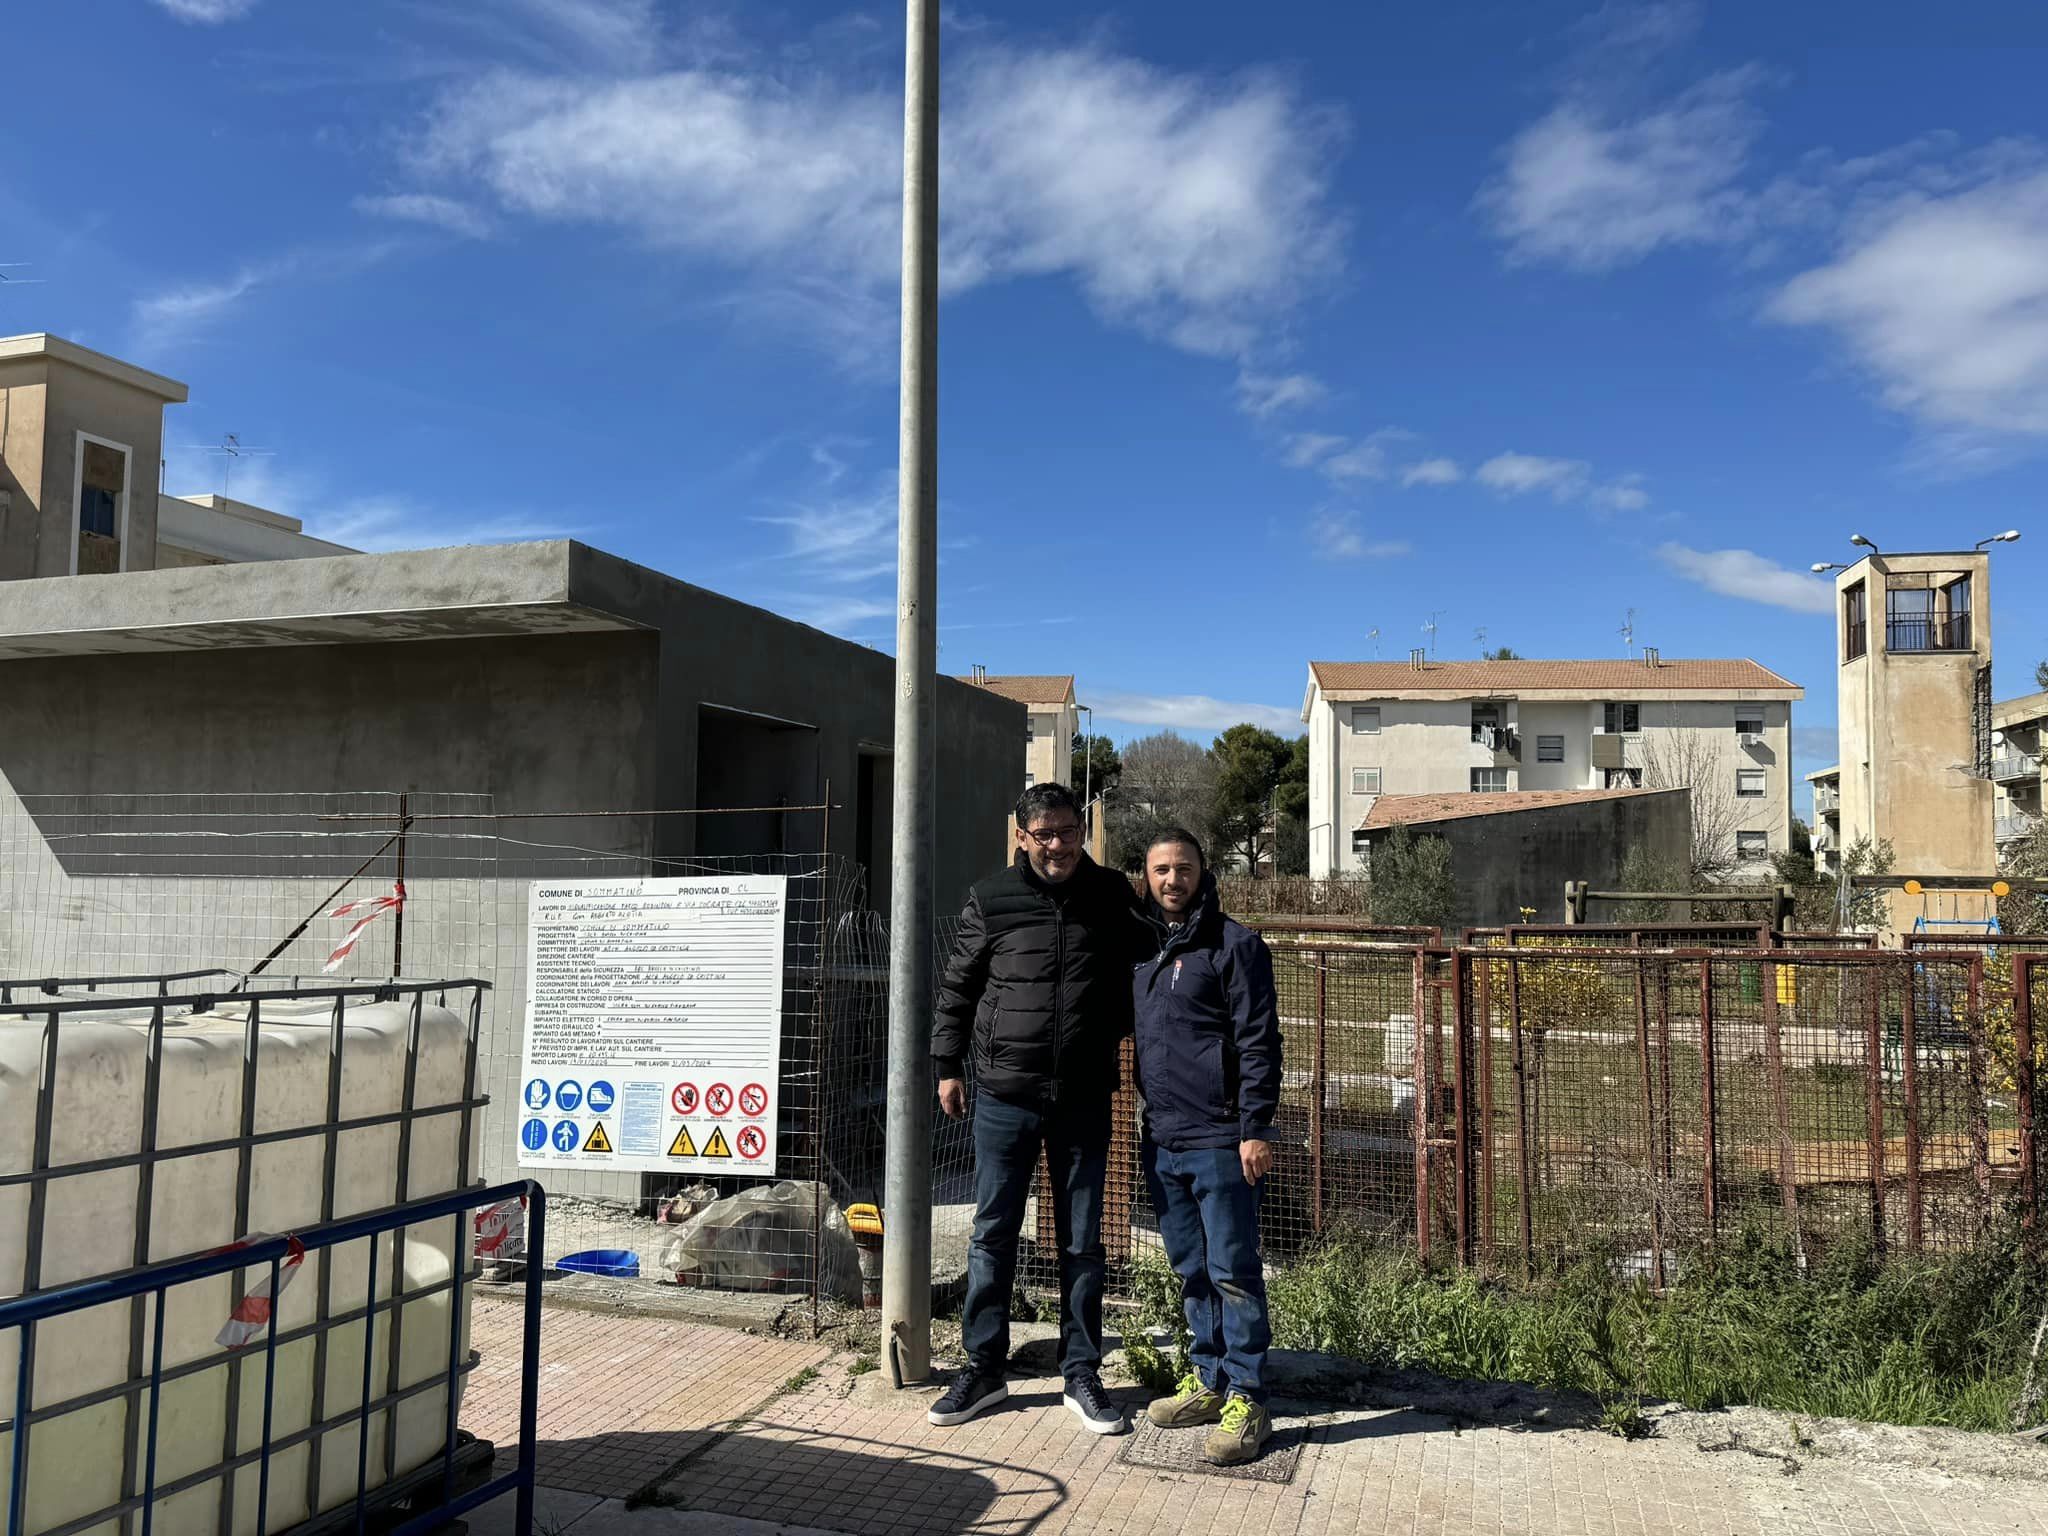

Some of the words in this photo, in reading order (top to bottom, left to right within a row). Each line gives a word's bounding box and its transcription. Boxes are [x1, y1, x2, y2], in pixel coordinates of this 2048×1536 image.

[538, 890, 573, 898] COMUNE
[574, 890, 582, 898] DI
[587, 887, 642, 896] SOMMATINO
[678, 887, 720, 895] PROVINCIA
[721, 886, 729, 894] DI
[738, 884, 750, 892] CL
